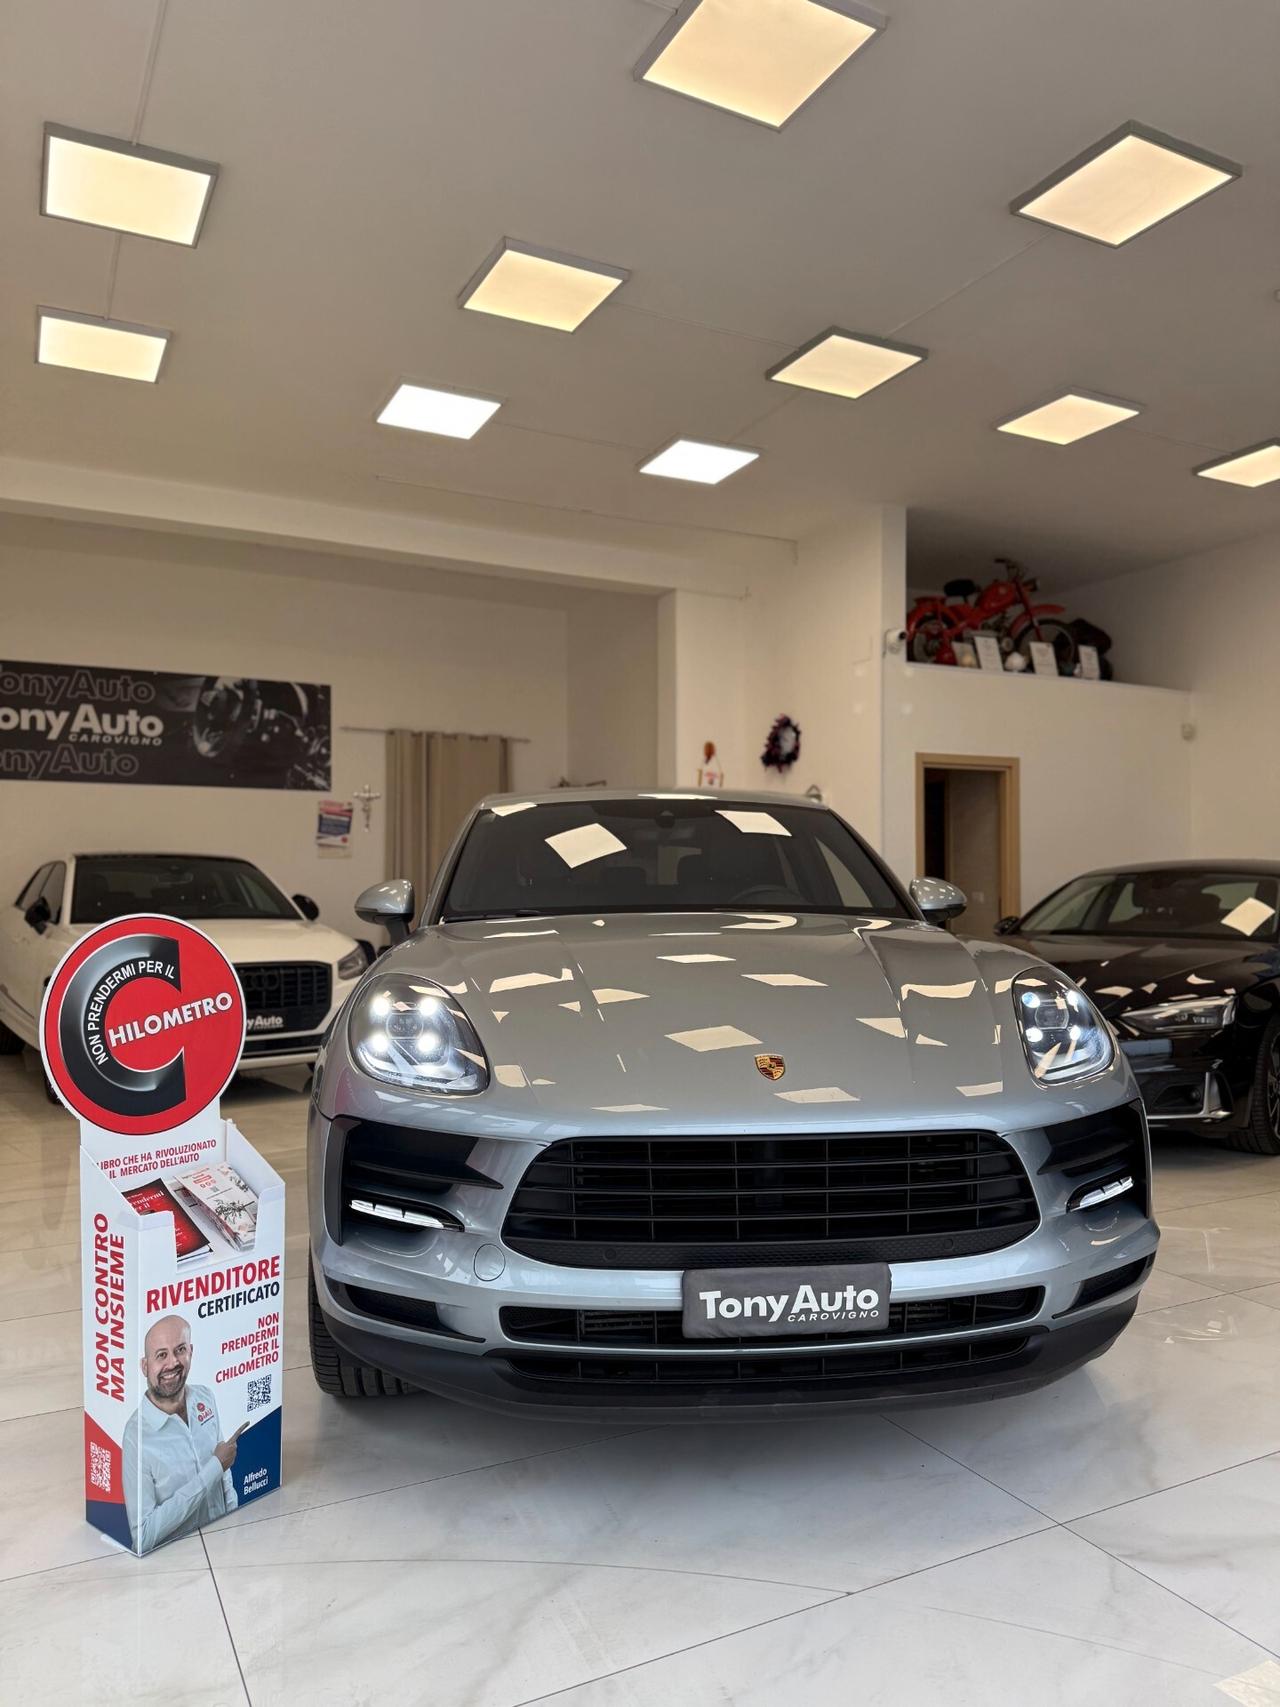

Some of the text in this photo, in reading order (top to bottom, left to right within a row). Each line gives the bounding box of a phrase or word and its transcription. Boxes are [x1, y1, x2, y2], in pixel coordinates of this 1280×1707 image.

[0, 664, 156, 704] onyAuto
[0, 703, 164, 740] onyAuto
[68, 733, 163, 746] CAROVIGNO
[87, 960, 175, 1065] NON PRENDERMI PER IL
[108, 992, 233, 1047] HILOMETRO
[247, 1015, 284, 1030] yAuto
[96, 1139, 217, 1170] IBRO CHE HA RIVOLUZIONATO
[109, 1153, 200, 1179] IL MERCATO DELL'AUTO
[146, 1255, 280, 1314] RIVENDITORE
[197, 1281, 280, 1319] CERTIFICATO
[94, 1213, 110, 1396] NON CONTRO
[110, 1233, 125, 1403] MA INSIEME
[258, 1312, 279, 1328] NON
[787, 1310, 879, 1322] CAROVIGNO
[221, 1325, 279, 1354] PRENDERMI
[251, 1338, 280, 1357] PER IL
[215, 1351, 279, 1383] CHILOMETRO
[243, 1467, 267, 1485] Alfredo
[243, 1475, 268, 1495] Bellucci
